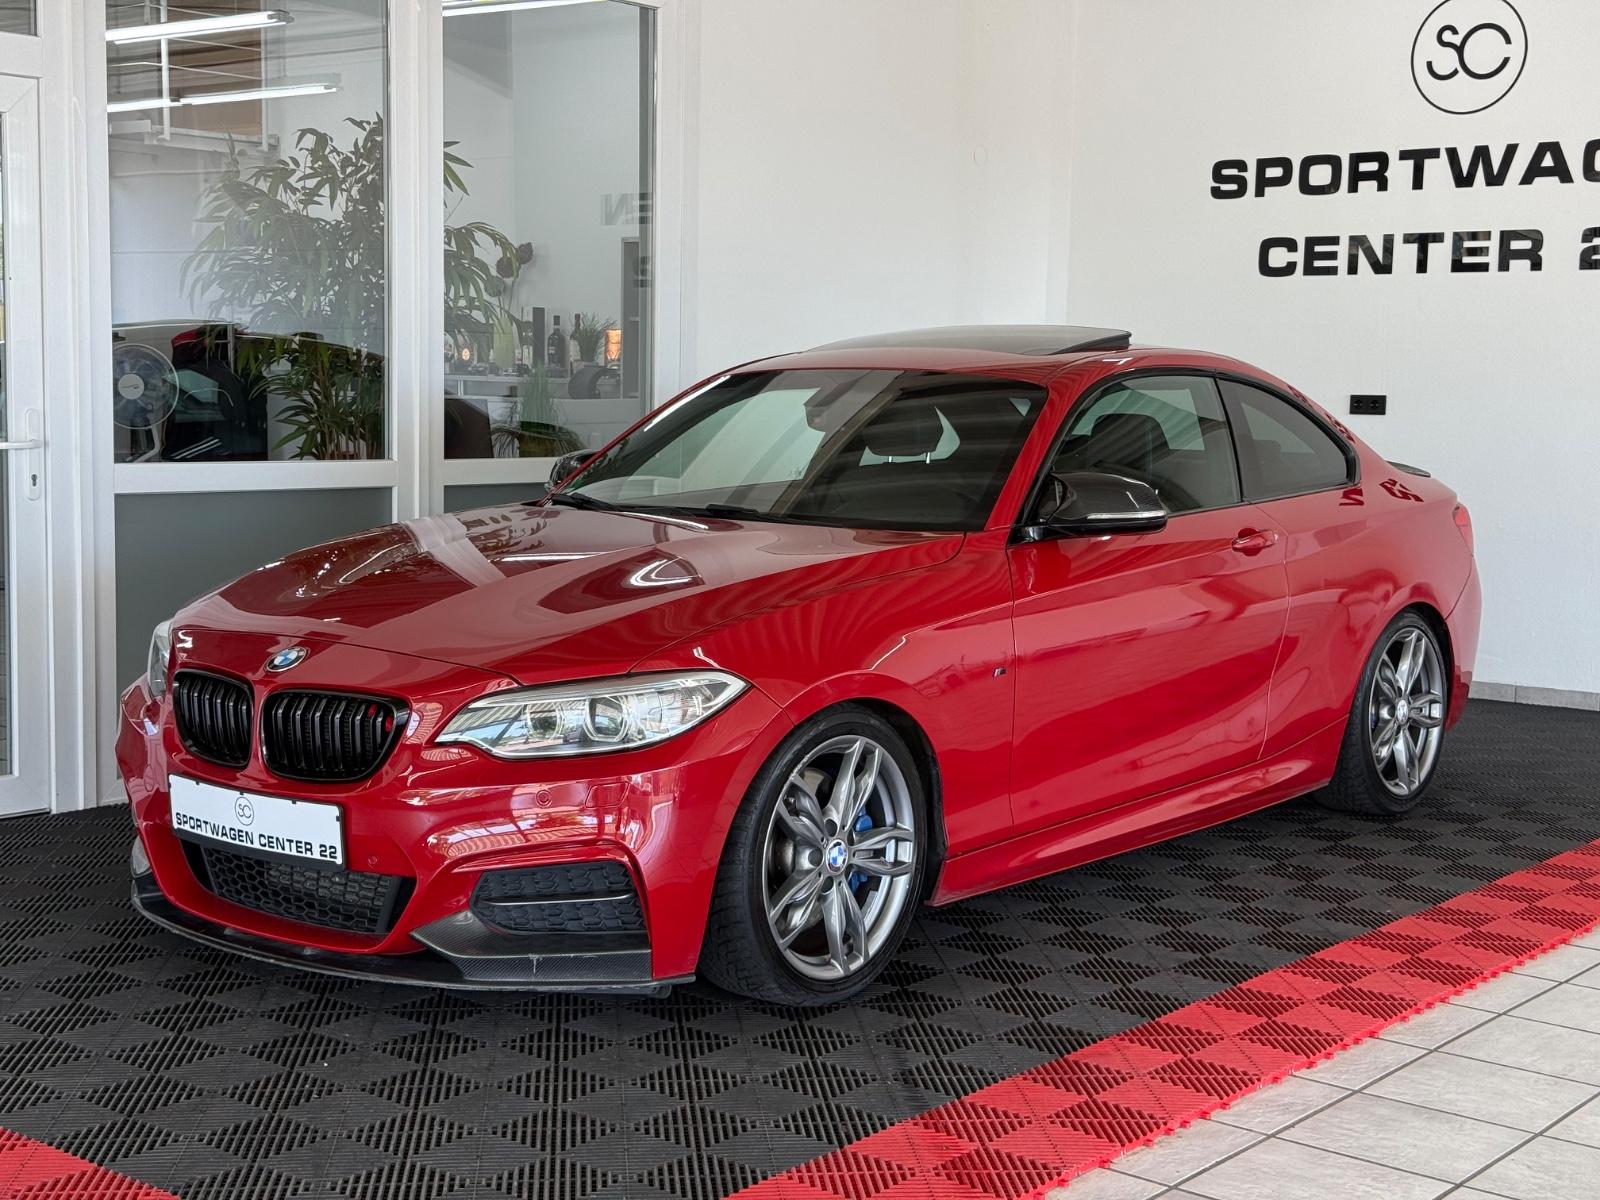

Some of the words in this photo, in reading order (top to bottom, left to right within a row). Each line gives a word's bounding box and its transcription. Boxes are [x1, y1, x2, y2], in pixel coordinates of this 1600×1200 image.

[1426, 22, 1512, 81] SC
[1258, 228, 1544, 278] CENTER
[175, 812, 254, 846] SPORTWAGEN
[258, 833, 313, 856] CENTER
[318, 843, 338, 860] 22
